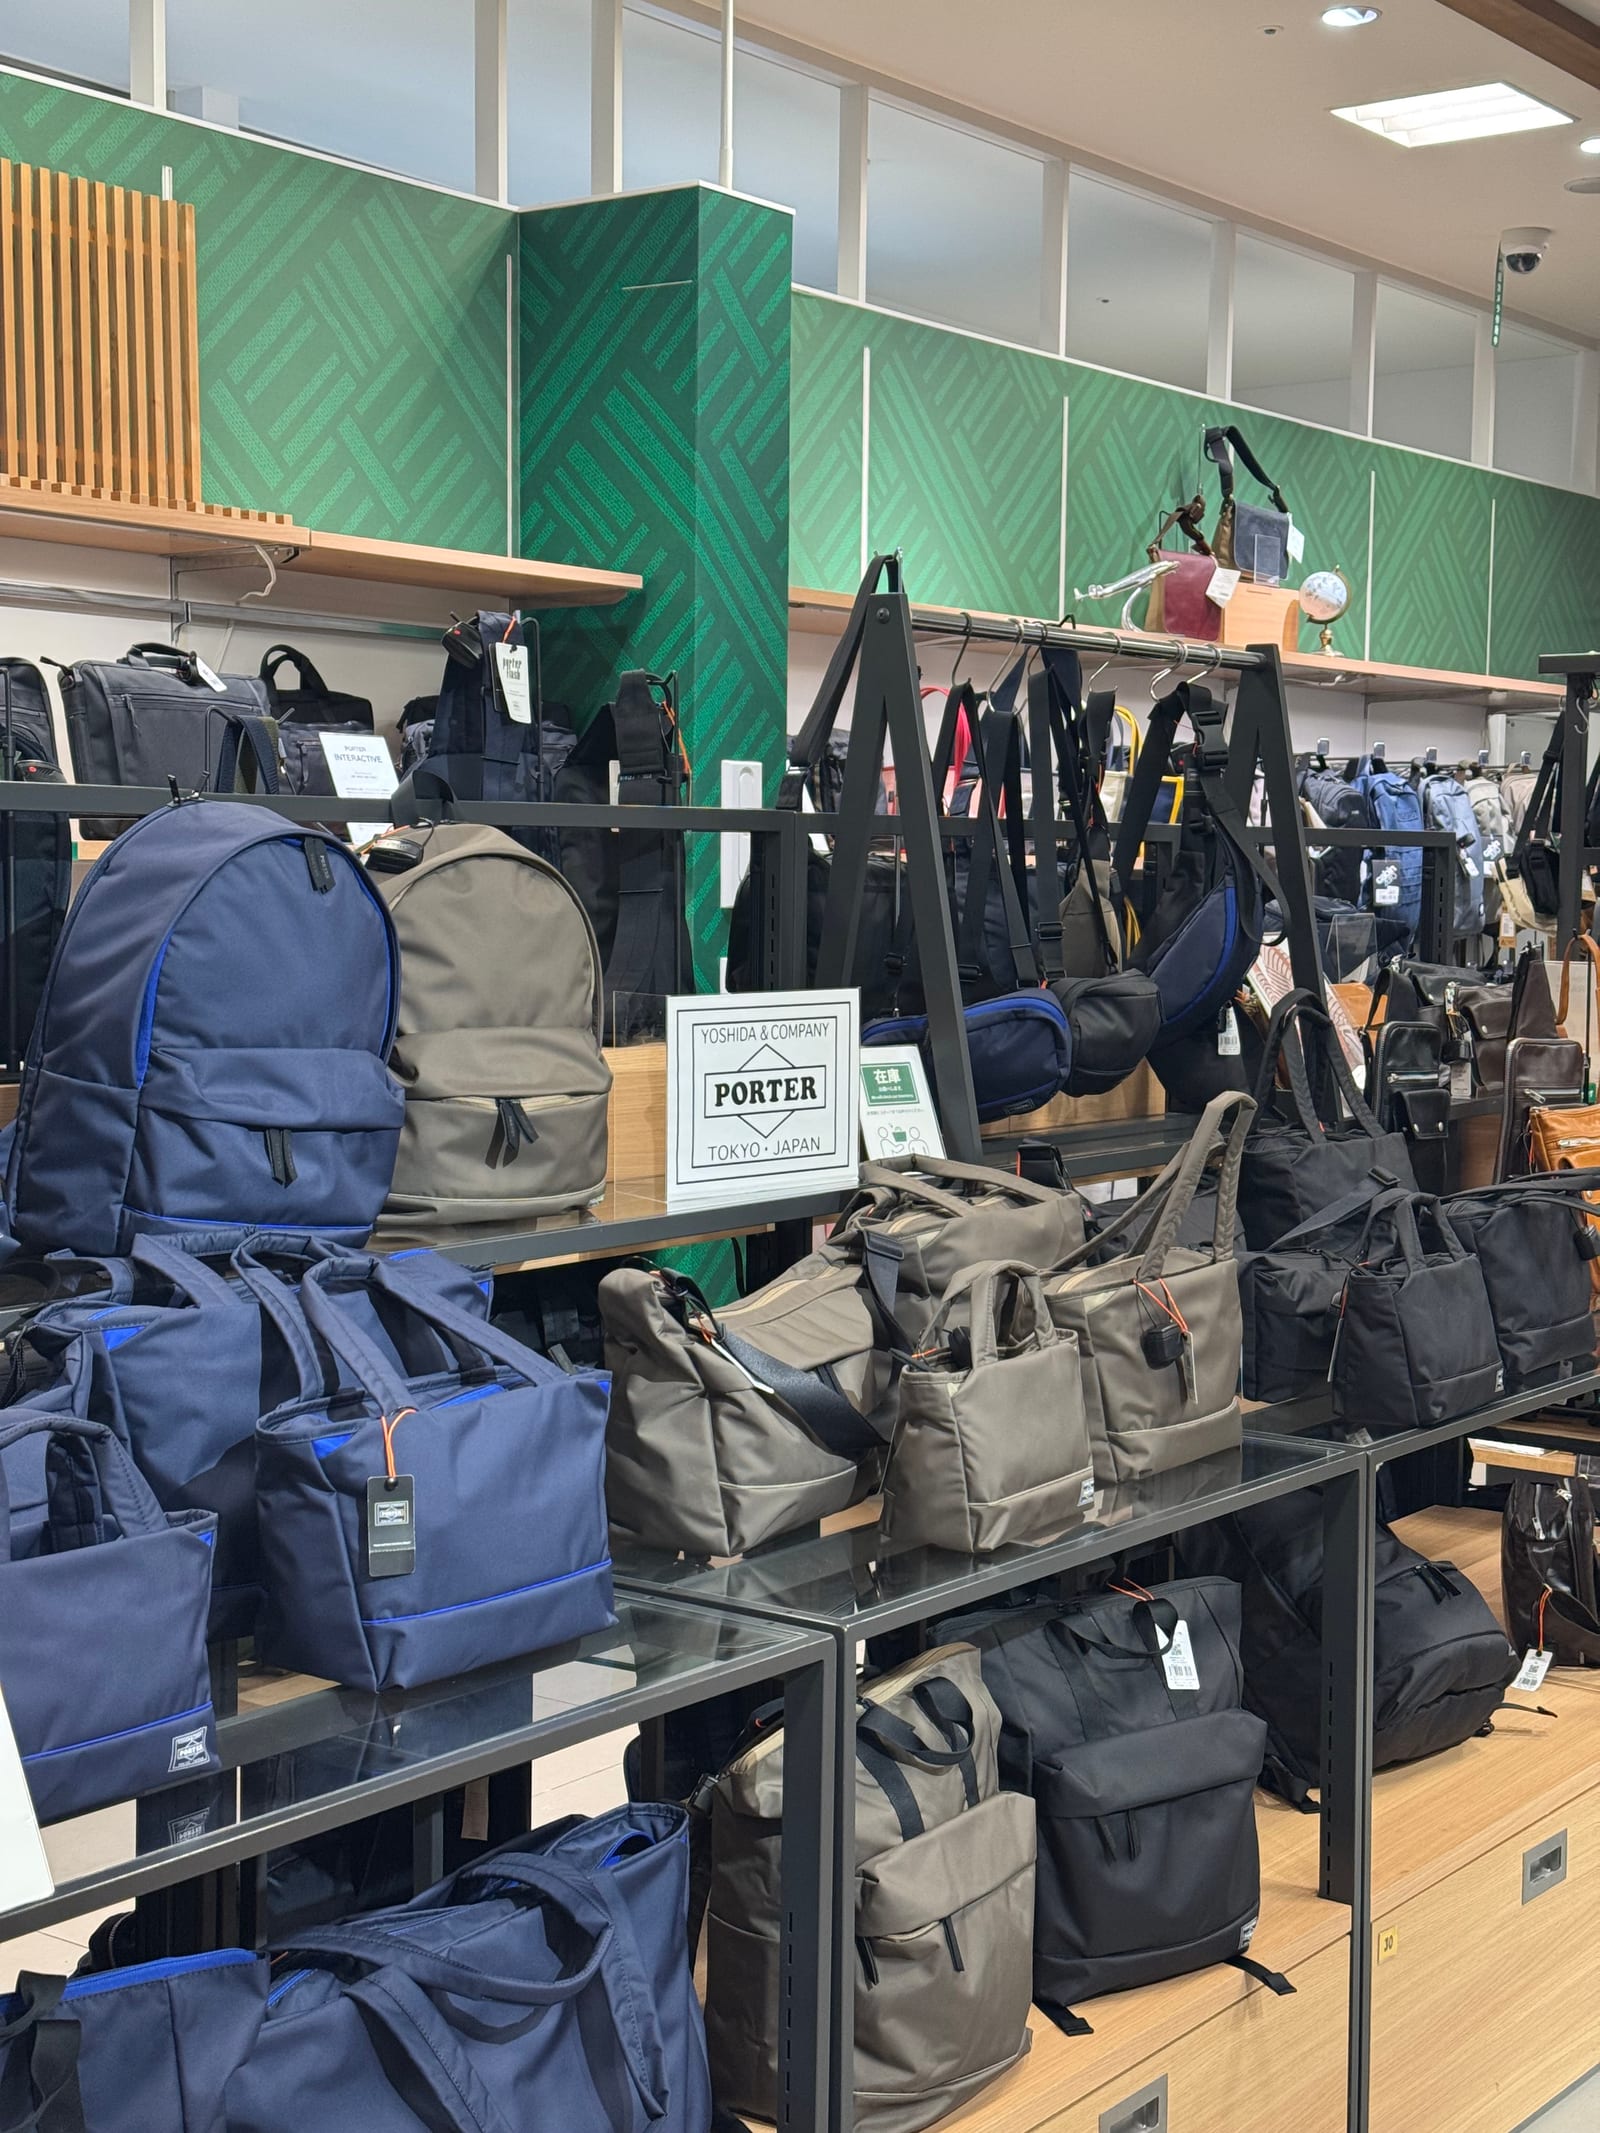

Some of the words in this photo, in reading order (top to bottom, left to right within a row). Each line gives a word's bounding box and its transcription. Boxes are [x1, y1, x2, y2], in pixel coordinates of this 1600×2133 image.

[334, 753, 383, 763] INTERACTIVE
[702, 1026, 757, 1044] YOSHIDA
[760, 1025, 769, 1041] &
[770, 1023, 829, 1040] COMPANY
[873, 1068, 901, 1084] 在庫
[714, 1076, 818, 1107] PORTER
[708, 1142, 761, 1161] TOKYO
[773, 1137, 820, 1156] JAPAN
